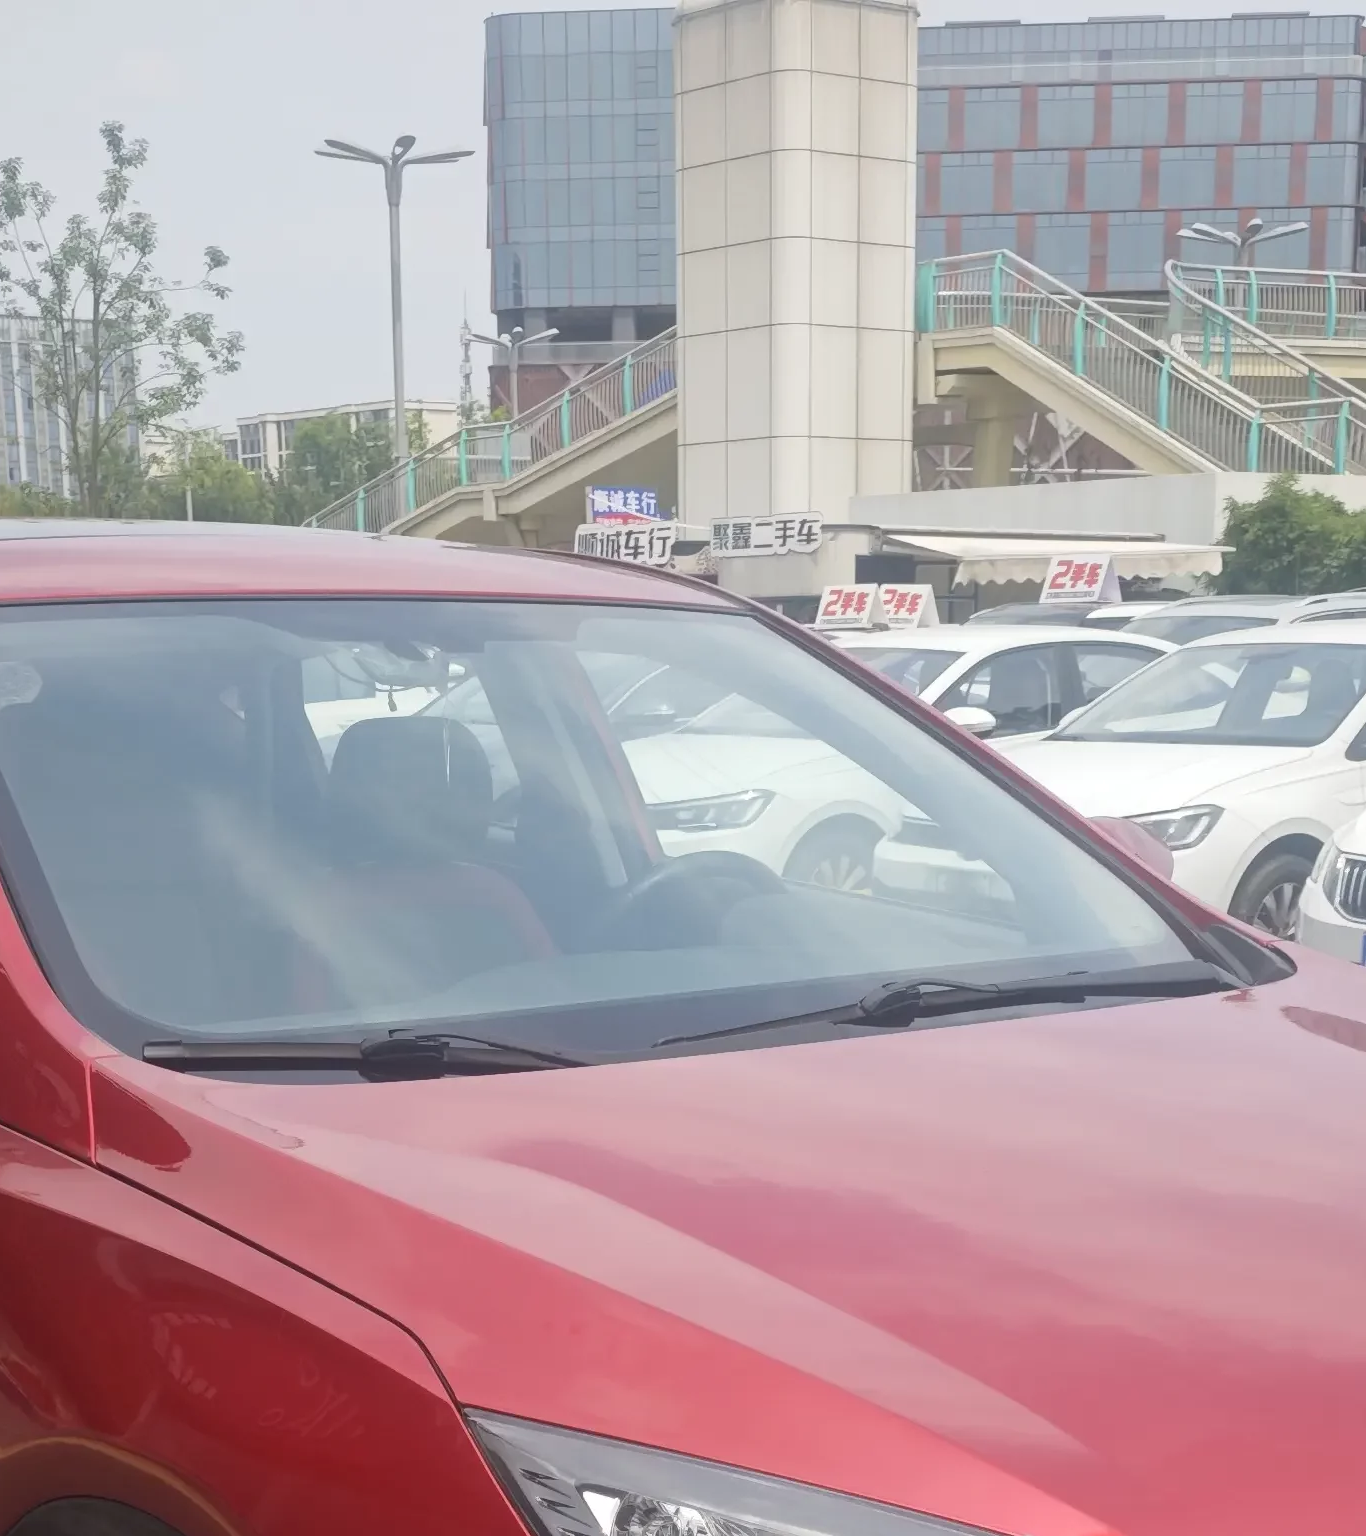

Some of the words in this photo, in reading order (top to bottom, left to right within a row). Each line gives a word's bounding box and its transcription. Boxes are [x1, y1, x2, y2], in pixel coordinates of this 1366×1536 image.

[713, 519, 820, 550] 聚鑫二手车
[1048, 560, 1103, 589] 2手车
[822, 589, 869, 616] 2手车
